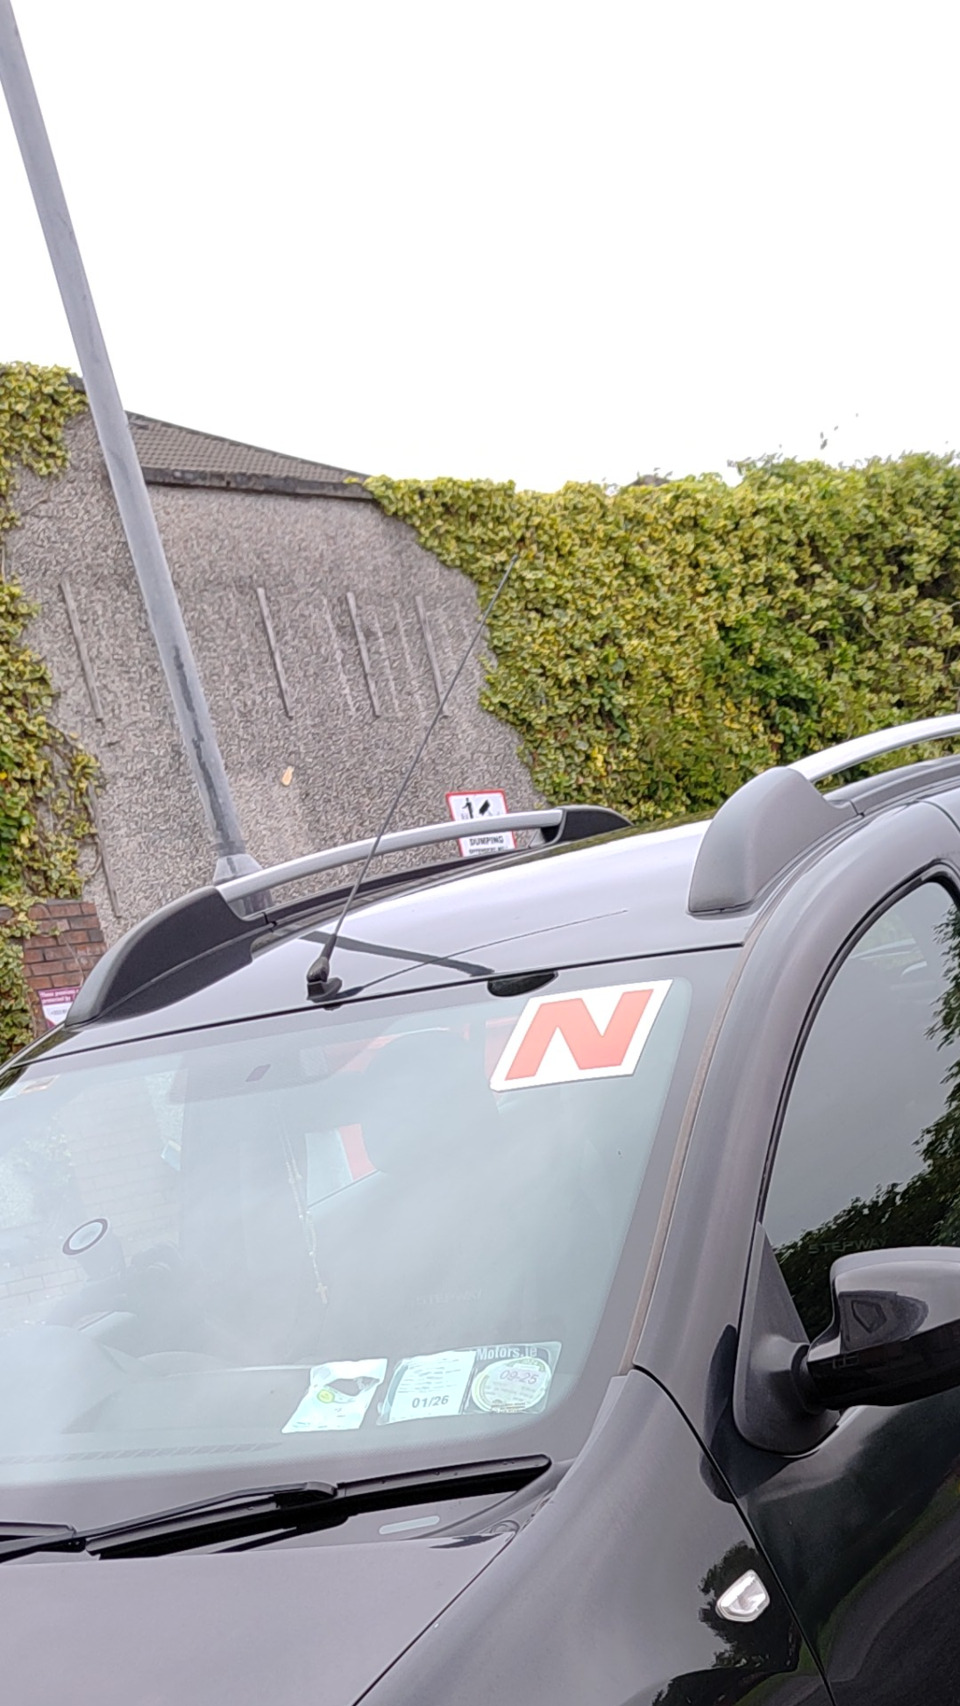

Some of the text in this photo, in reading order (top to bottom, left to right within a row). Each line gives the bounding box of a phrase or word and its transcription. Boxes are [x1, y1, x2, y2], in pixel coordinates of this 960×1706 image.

[468, 836, 504, 847] DUMPING
[505, 988, 654, 1081] N
[500, 1369, 539, 1385] 09-25
[411, 1394, 450, 1409] 01/26
